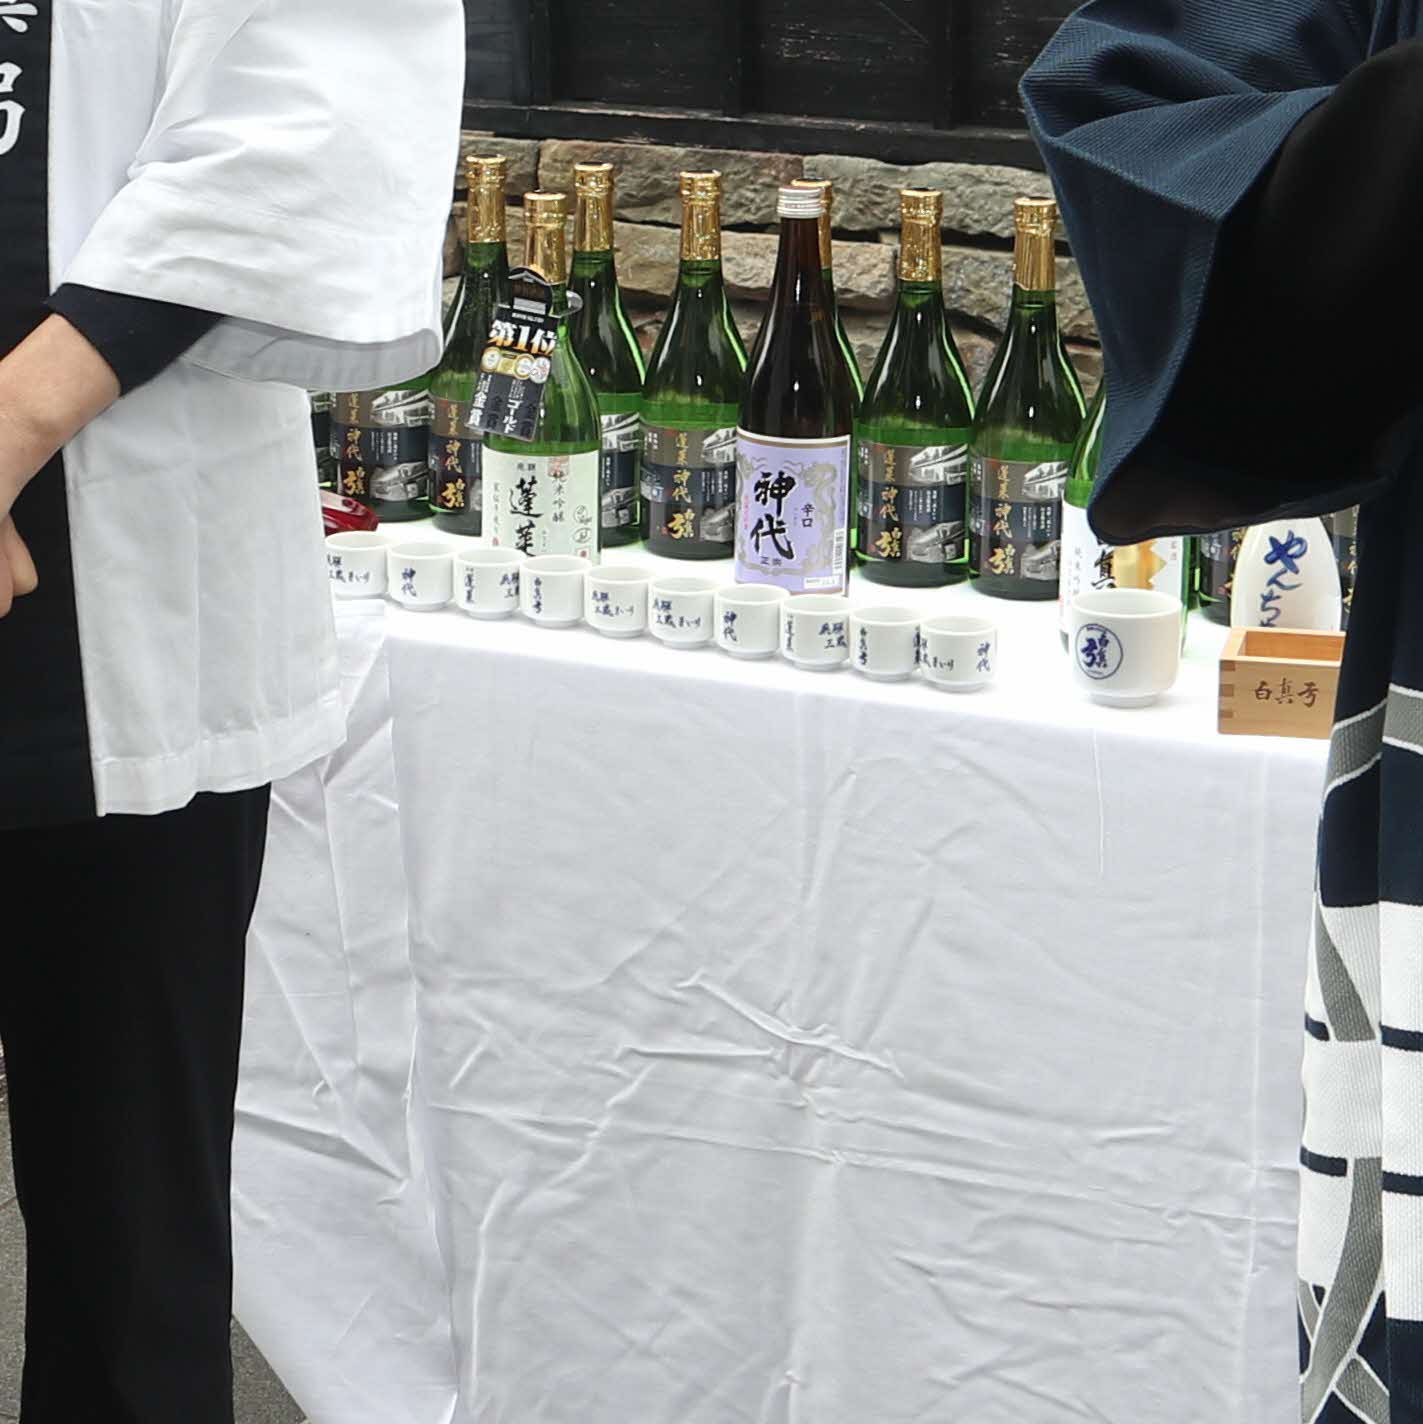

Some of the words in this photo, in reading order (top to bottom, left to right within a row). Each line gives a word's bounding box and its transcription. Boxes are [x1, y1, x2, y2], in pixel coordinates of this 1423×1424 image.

[508, 475, 545, 557] 蓬莱
[750, 469, 797, 560] 神代
[801, 503, 816, 528] 辛口
[1254, 677, 1320, 709] 白真弓
